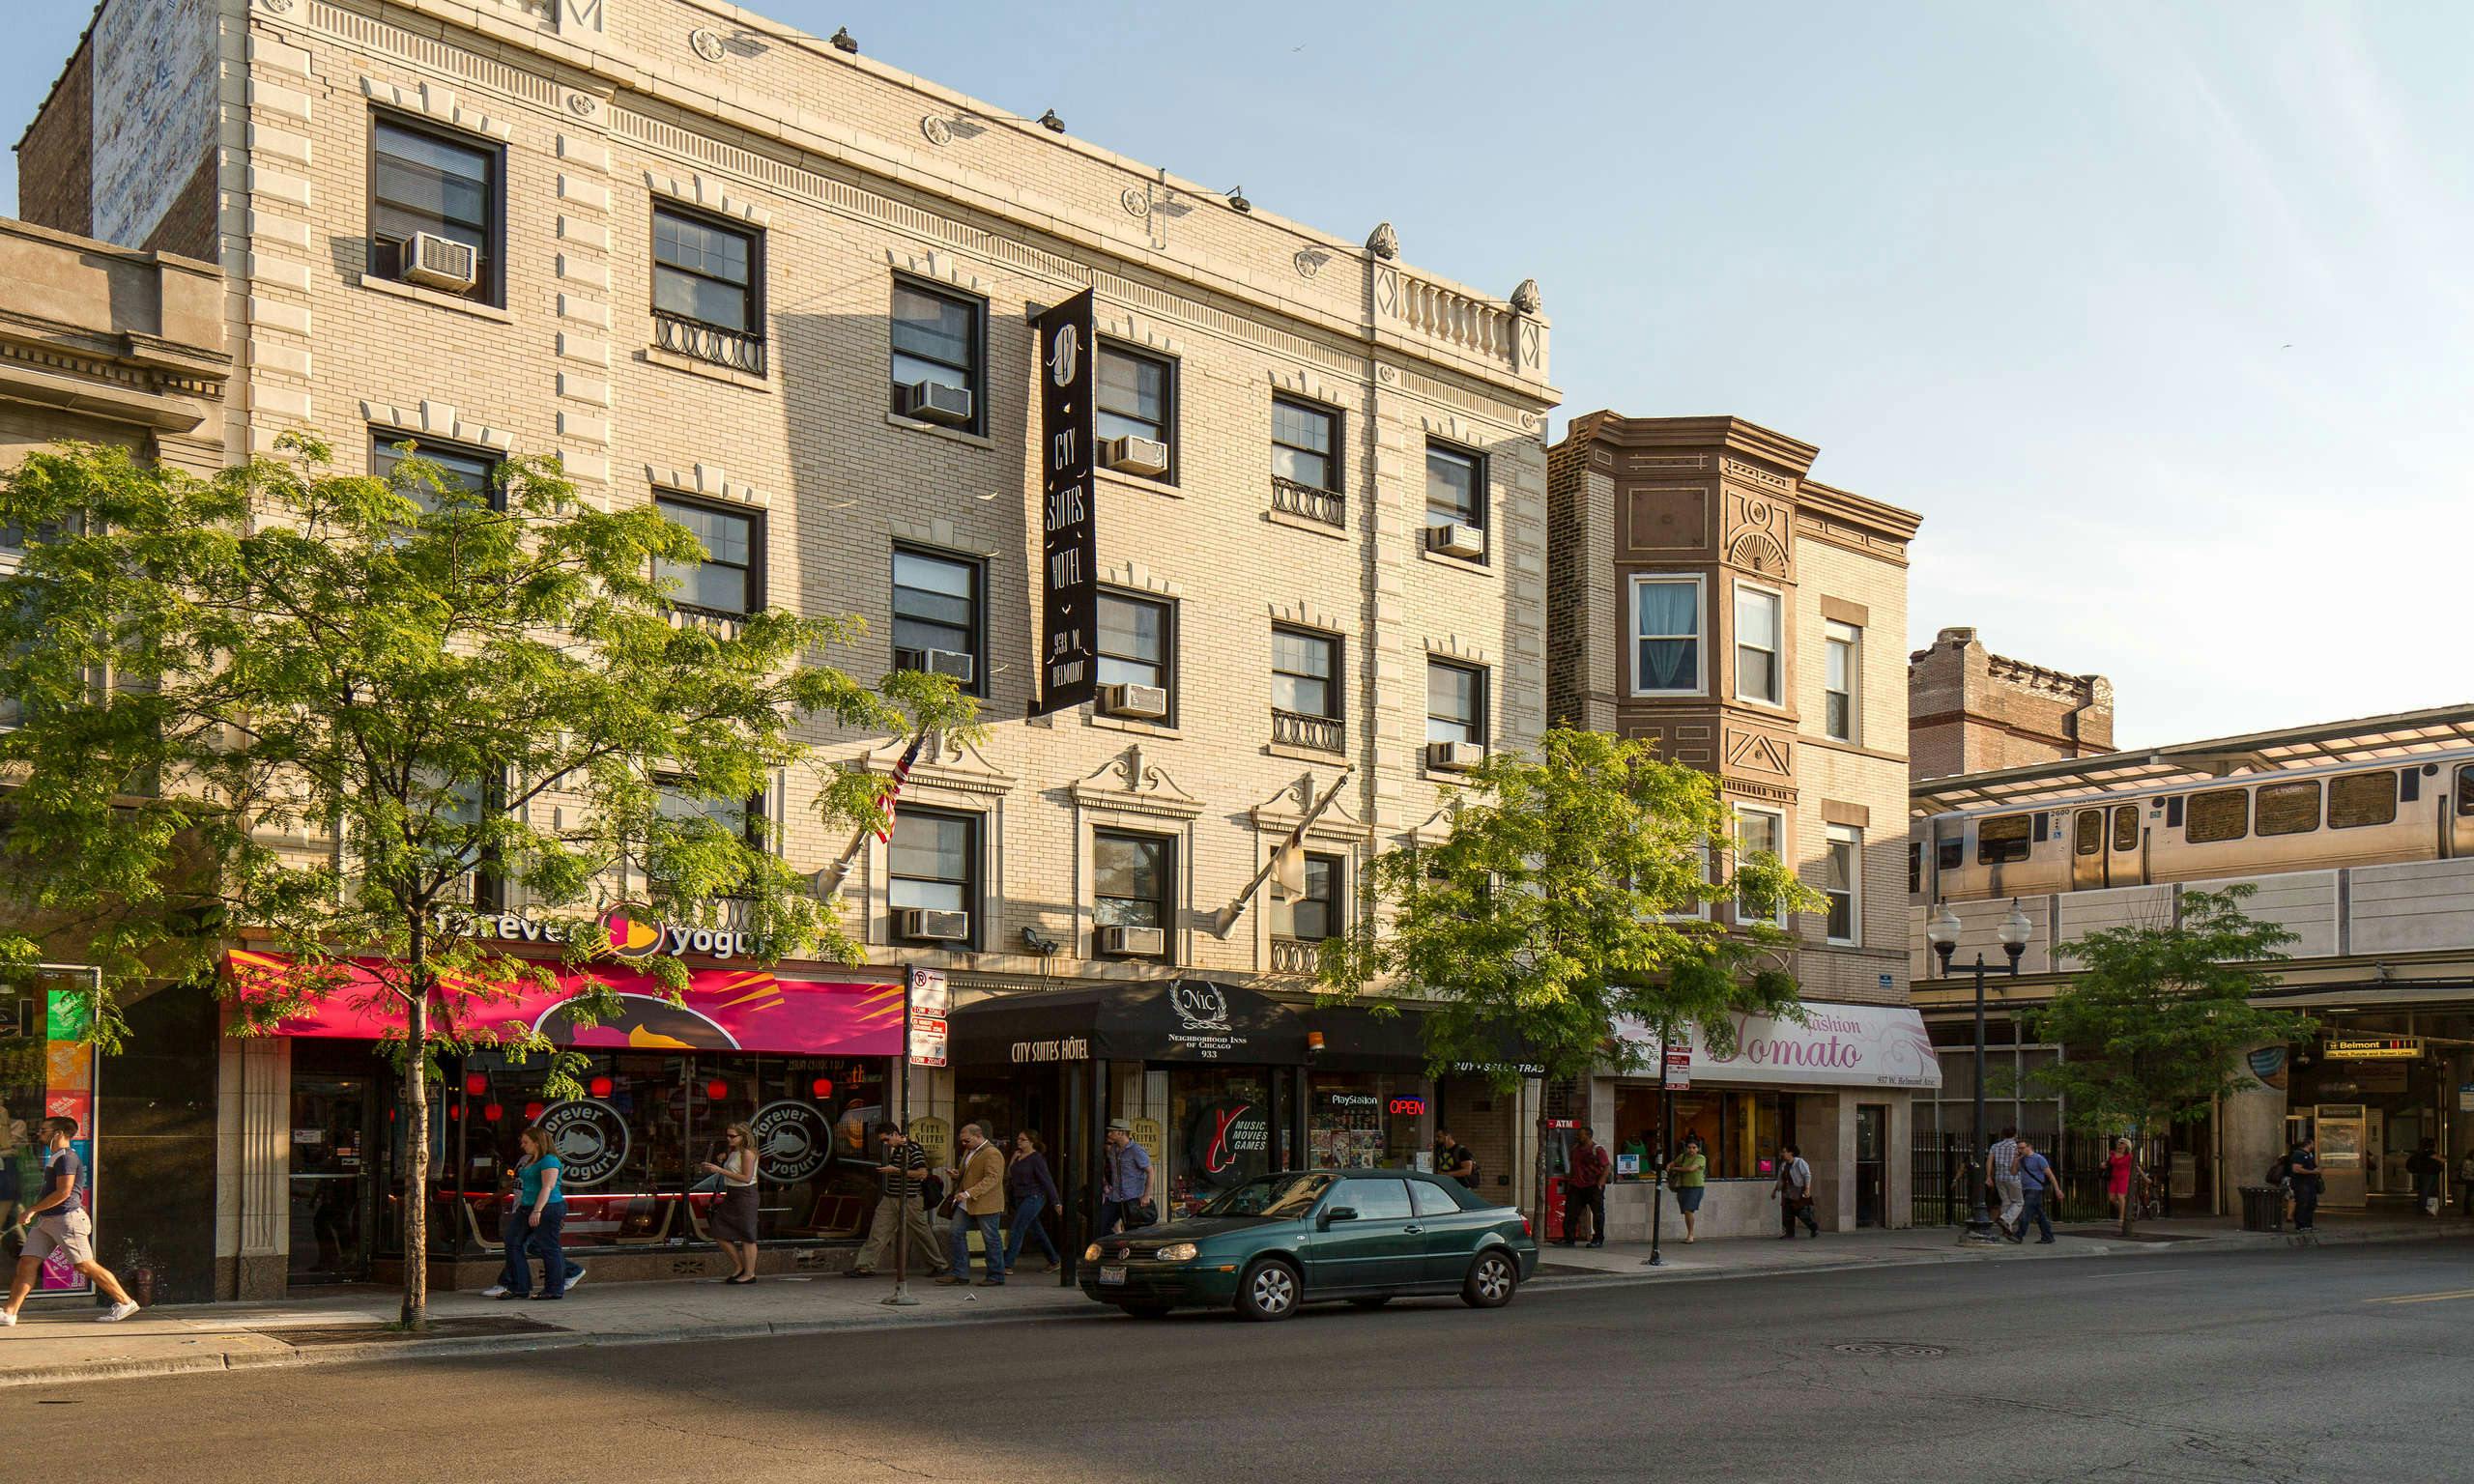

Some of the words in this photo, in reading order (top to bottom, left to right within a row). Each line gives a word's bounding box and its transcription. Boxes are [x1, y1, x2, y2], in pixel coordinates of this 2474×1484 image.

[1054, 426, 1076, 471] CITY
[1047, 485, 1084, 531] SUITES
[1051, 547, 1083, 590] HOTEL
[1052, 660, 1084, 688] BELMONT
[671, 928, 769, 959] yogu
[927, 1008, 943, 1016] ZONE
[1705, 1009, 1863, 1069] Tomato
[927, 1057, 943, 1066] ZONE
[1011, 1042, 1031, 1063] CITY
[1032, 1040, 1059, 1063] SUITES
[1518, 1064, 1546, 1073] TRAD
[1898, 1076, 1922, 1086] Belmont
[1332, 1094, 1378, 1106] PlayStation
[1390, 1099, 1425, 1116] OPEN
[545, 1106, 603, 1135] orever
[753, 1109, 810, 1138] forever
[1235, 1120, 1266, 1130] MUSIC
[1555, 1120, 1573, 1128] ATM
[1233, 1130, 1268, 1141] MOVIES
[1234, 1140, 1265, 1151] GAMES
[768, 1149, 823, 1177] yogurt
